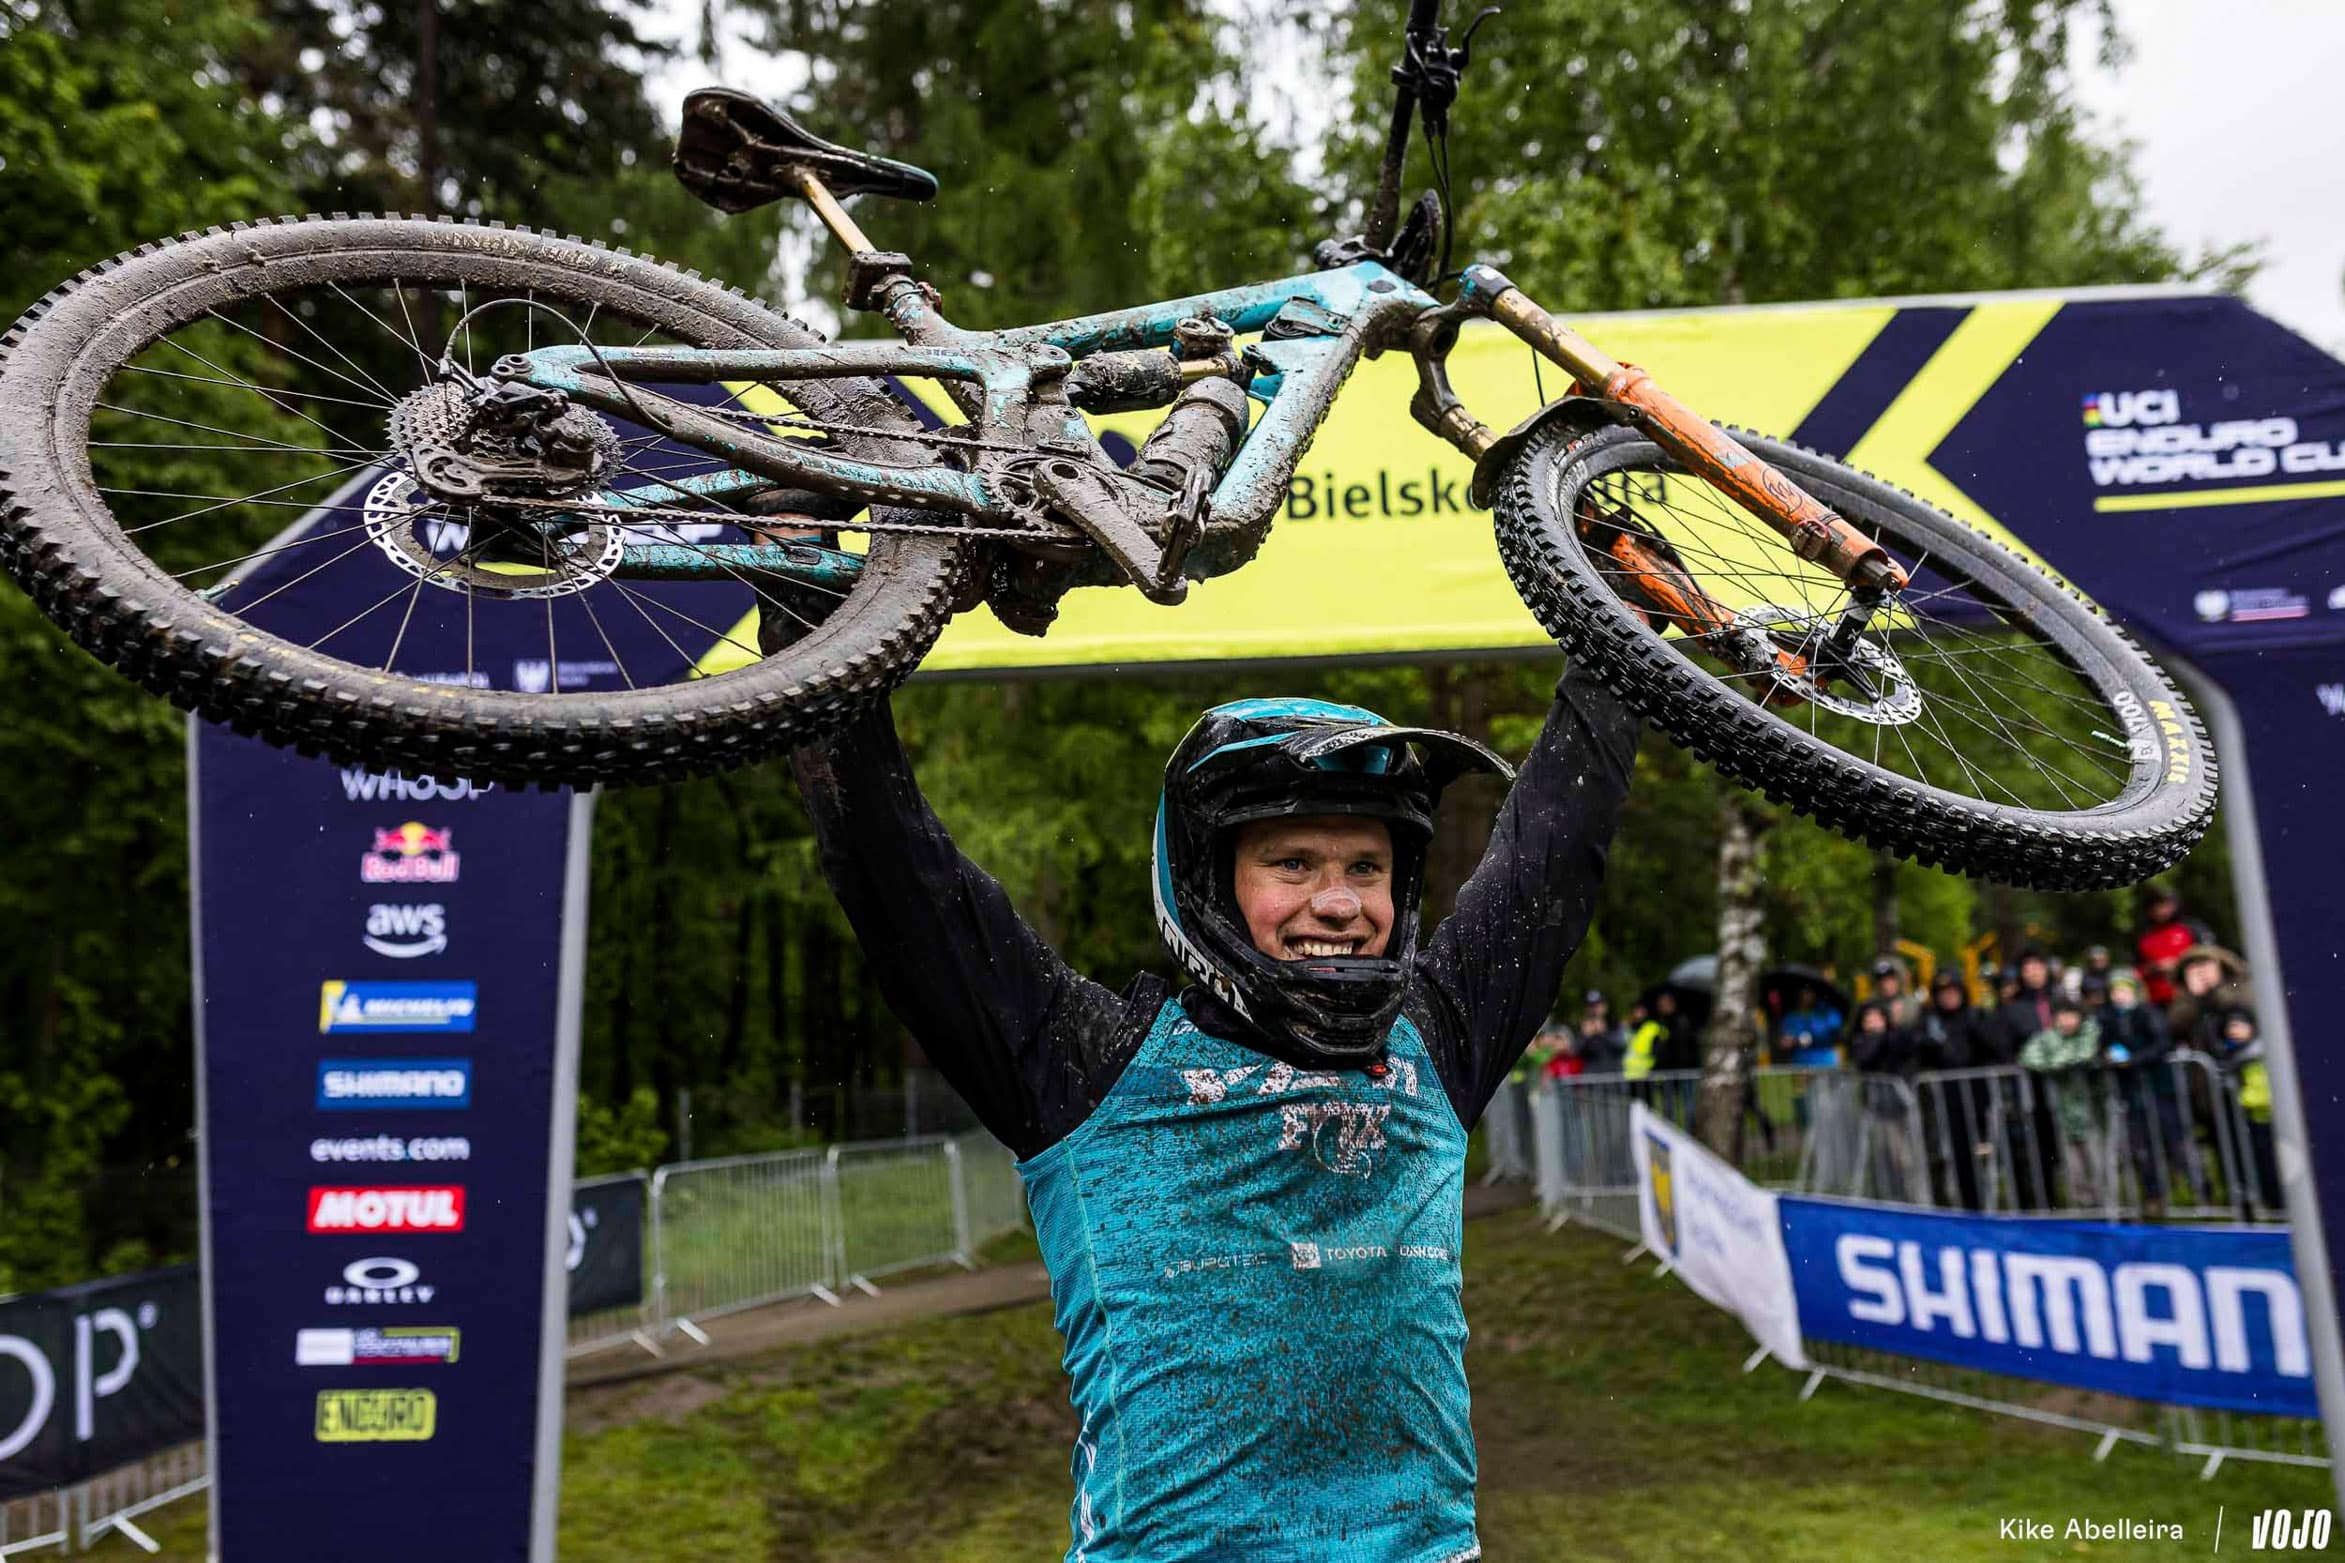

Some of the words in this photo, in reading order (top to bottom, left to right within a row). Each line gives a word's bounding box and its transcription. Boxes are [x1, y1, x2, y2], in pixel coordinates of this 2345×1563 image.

[2099, 389, 2180, 426] UCI
[366, 903, 447, 936] aws
[310, 1134, 470, 1162] events.com
[313, 1191, 459, 1228] MOTUL
[1326, 1245, 1387, 1261] TOYOTA
[324, 1286, 435, 1304] OAKLEY
